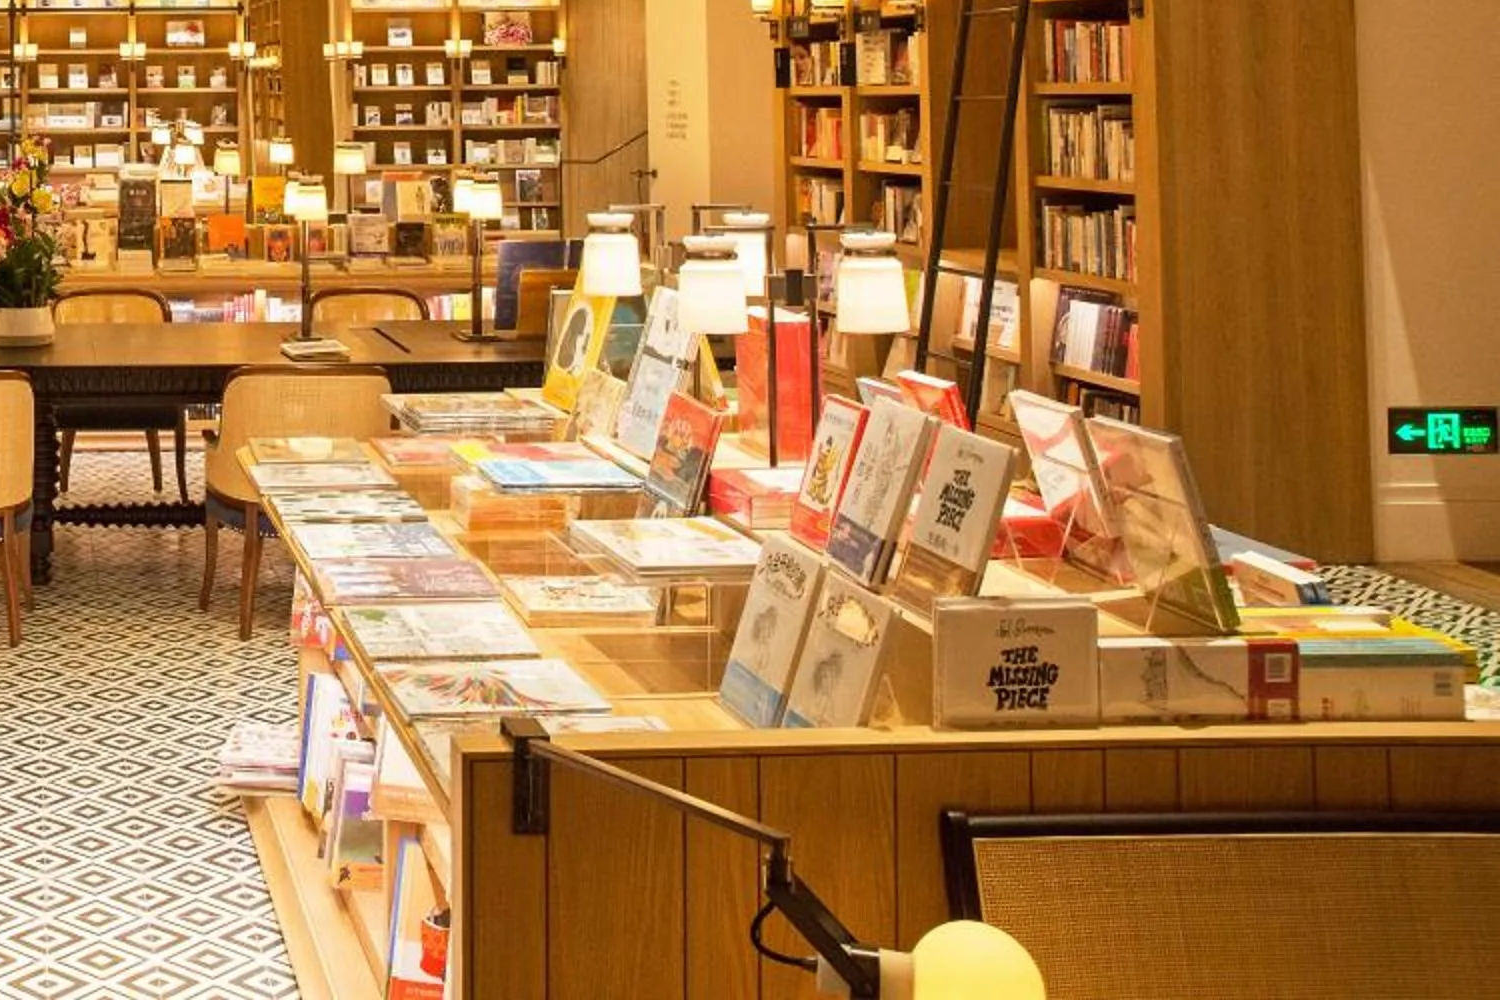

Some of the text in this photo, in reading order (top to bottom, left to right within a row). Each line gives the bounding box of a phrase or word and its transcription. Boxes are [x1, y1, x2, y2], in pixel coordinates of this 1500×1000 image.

[1000, 645, 1039, 665] THE
[986, 661, 1060, 687] MISSING
[994, 686, 1050, 712] PIECE
